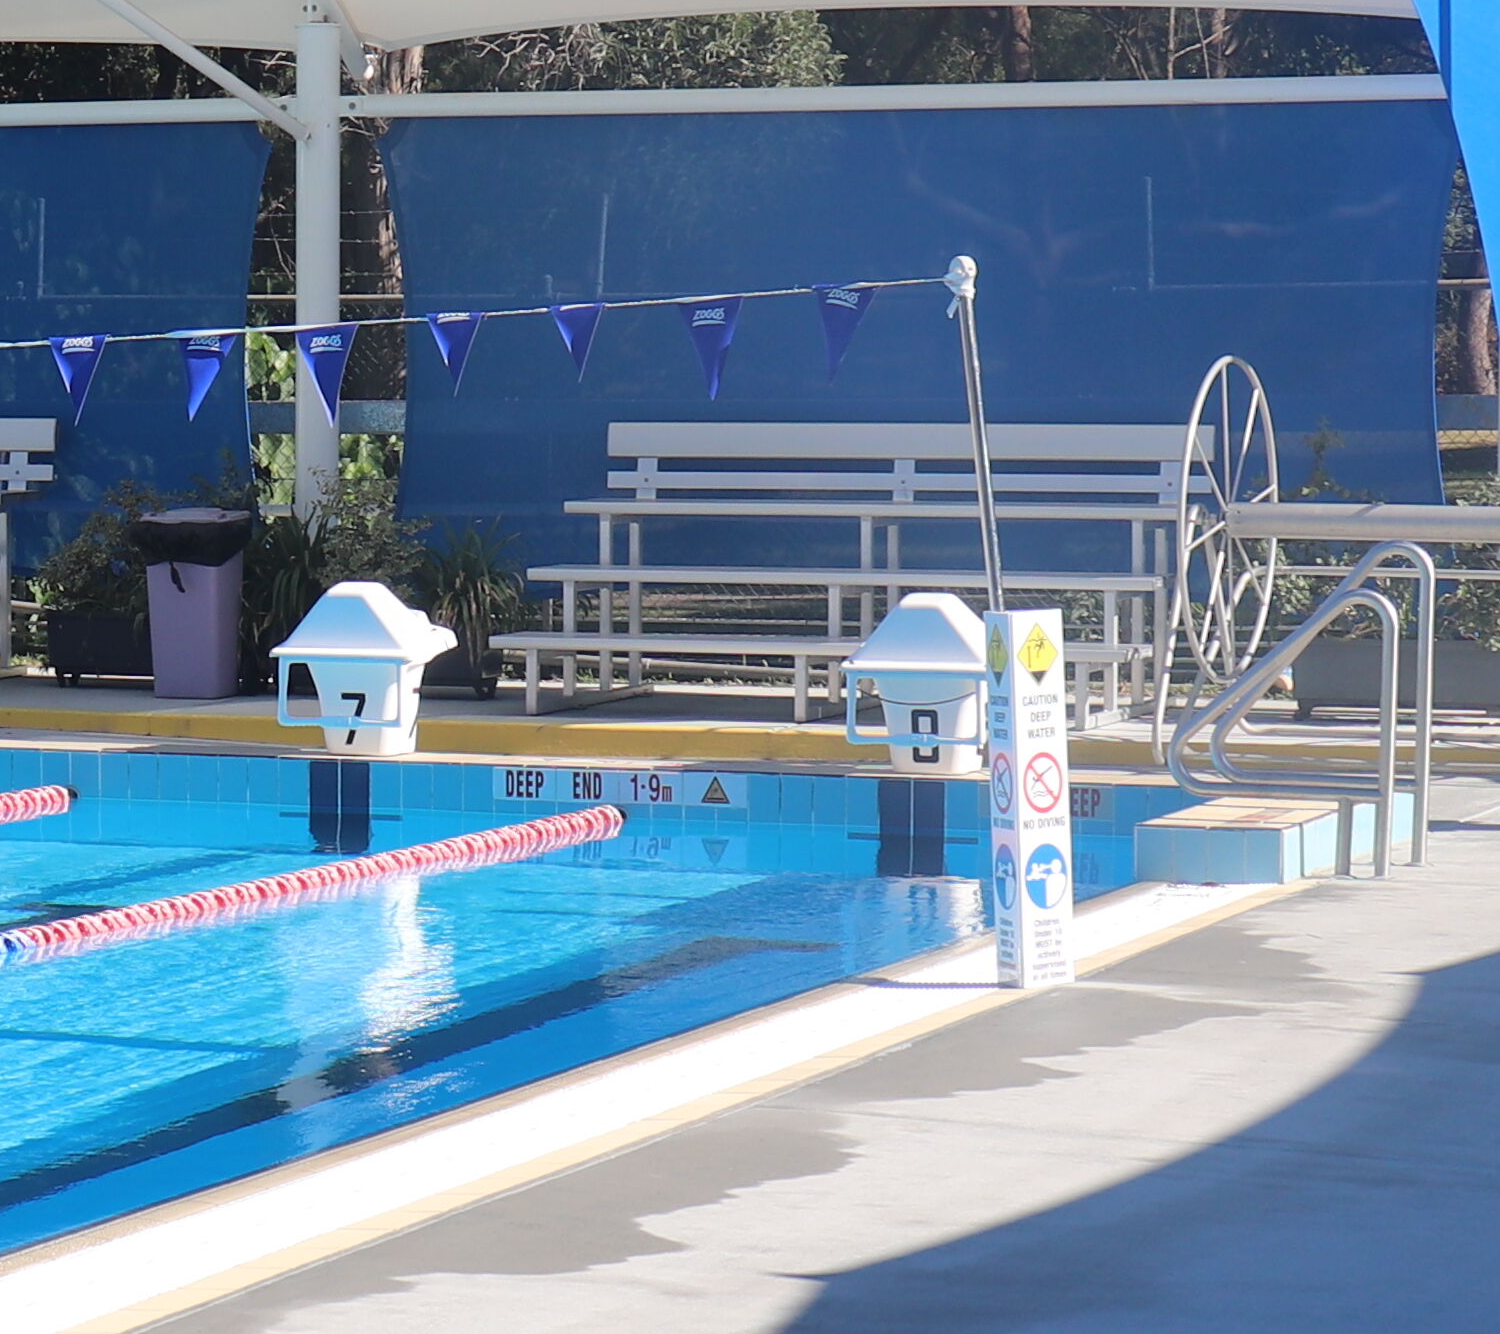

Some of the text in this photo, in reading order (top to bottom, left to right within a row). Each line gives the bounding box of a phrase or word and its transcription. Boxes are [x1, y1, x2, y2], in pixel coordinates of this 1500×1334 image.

[1022, 695, 1058, 707] CAUTION
[341, 693, 366, 745] 7
[1031, 711, 1051, 722] DEEP
[1027, 727, 1055, 739] WATER
[506, 769, 544, 799] DEEP
[572, 771, 602, 800] END
[1071, 788, 1101, 818] EEP
[1023, 820, 1034, 830] NO
[1038, 816, 1066, 829] DIVING
